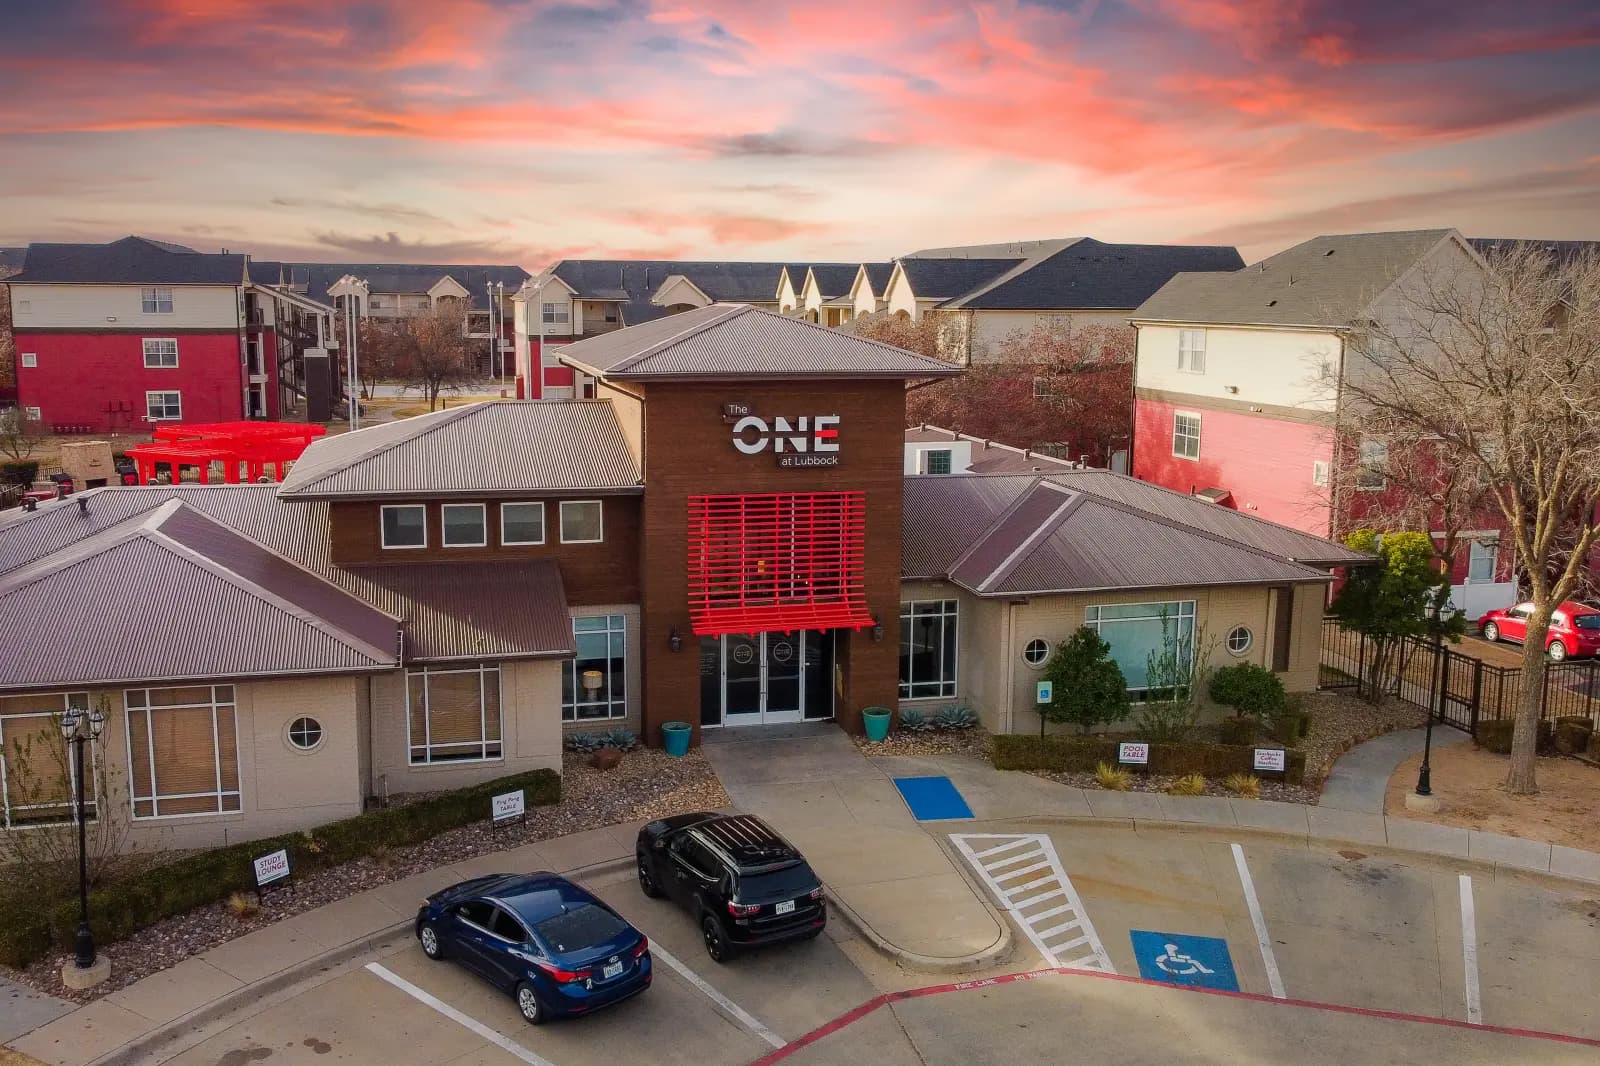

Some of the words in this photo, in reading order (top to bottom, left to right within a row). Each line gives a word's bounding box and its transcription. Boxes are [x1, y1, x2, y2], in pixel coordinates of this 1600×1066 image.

[728, 404, 748, 414] The
[732, 416, 840, 455] ONE
[781, 458, 792, 466] at
[795, 455, 838, 466] Lubbock
[257, 860, 286, 877] LOUNGE
[260, 855, 281, 869] STUDY
